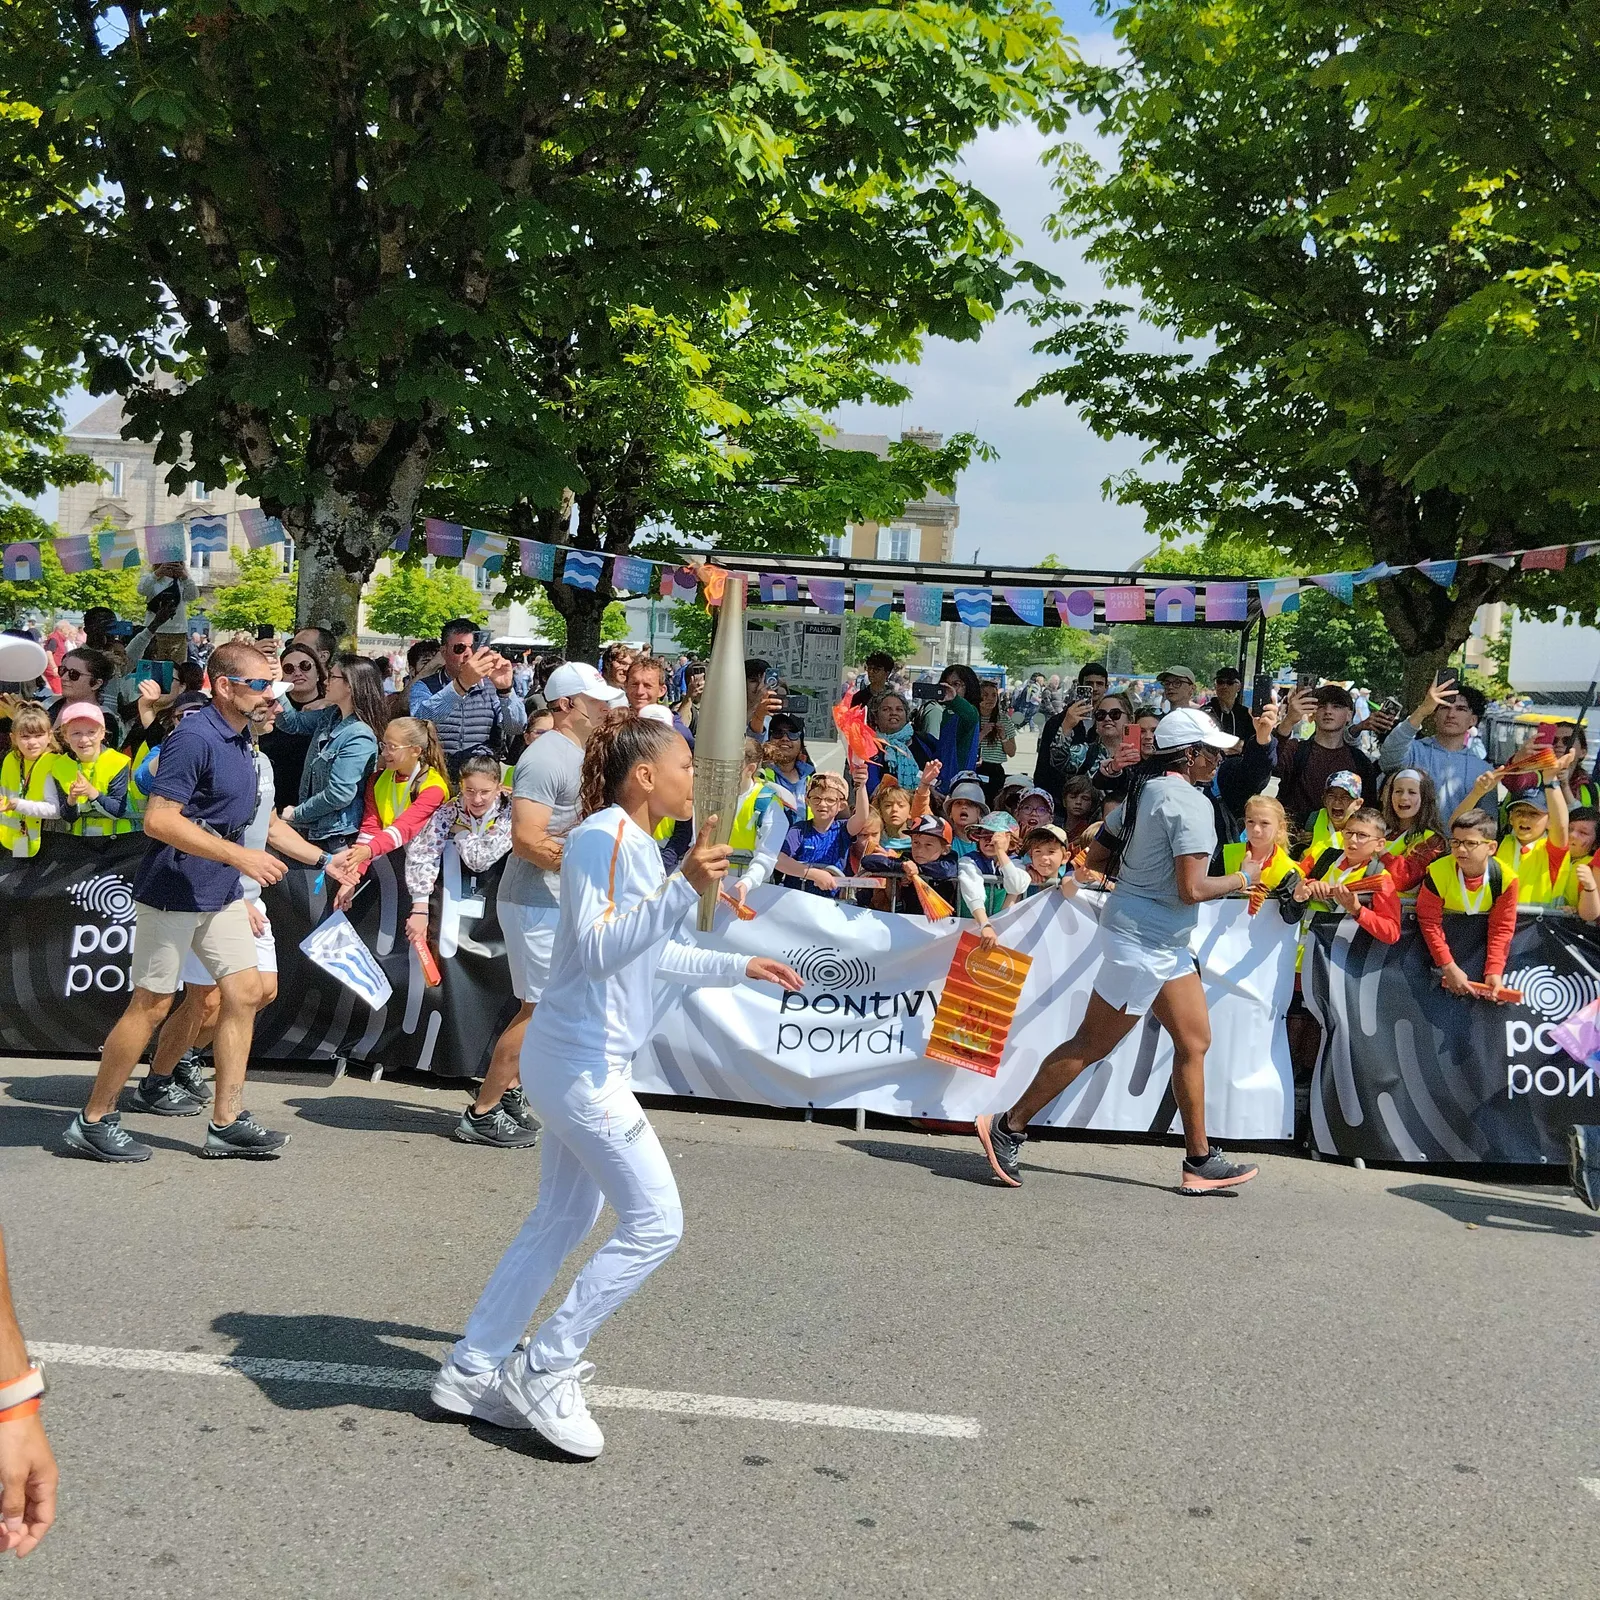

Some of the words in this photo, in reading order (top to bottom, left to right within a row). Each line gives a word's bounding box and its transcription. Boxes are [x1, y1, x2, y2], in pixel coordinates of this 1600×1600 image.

[523, 551, 549, 561] PARIS
[524, 560, 549, 570] 2024
[1109, 591, 1140, 600] PARIS
[908, 597, 937, 606] PARIS
[1111, 600, 1141, 609] 2024
[909, 605, 937, 615] 2024
[929, 1050, 980, 1072] PARTENAIRE
